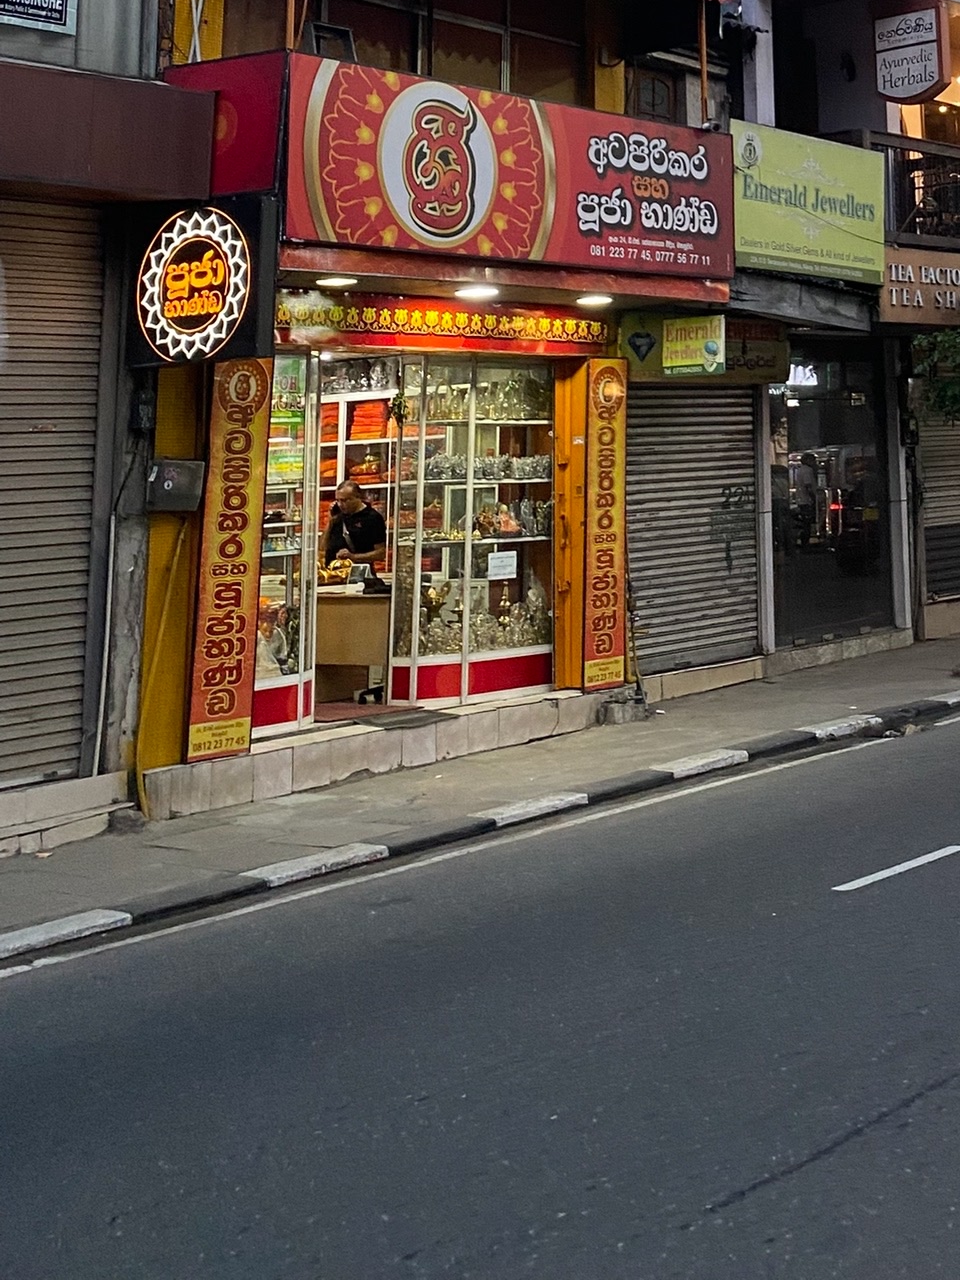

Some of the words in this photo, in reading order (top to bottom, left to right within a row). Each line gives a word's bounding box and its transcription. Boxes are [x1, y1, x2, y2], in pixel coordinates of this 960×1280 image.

[880, 48, 933, 75] Ayurvedic
[882, 65, 935, 90] Herbals
[588, 132, 708, 180] අටපිරිකර
[742, 173, 807, 209] Emerald
[811, 187, 875, 222] Jewellers
[577, 188, 633, 232] පූජා
[641, 197, 718, 234] භාණ්ඩ
[590, 245, 605, 256] 081
[609, 246, 625, 258] 223
[628, 248, 638, 259] 77
[655, 251, 674, 262] 0777
[677, 253, 687, 263] 56
[689, 255, 699, 265] 77
[702, 256, 710, 265] 11
[166, 249, 225, 300] පූජා
[890, 263, 914, 282] TEA
[889, 288, 923, 307] TEA
[666, 319, 719, 343] Emerald
[193, 739, 212, 752] 0812
[213, 738, 223, 749] 23
[224, 737, 234, 747] 77
[234, 736, 246, 746] 45
